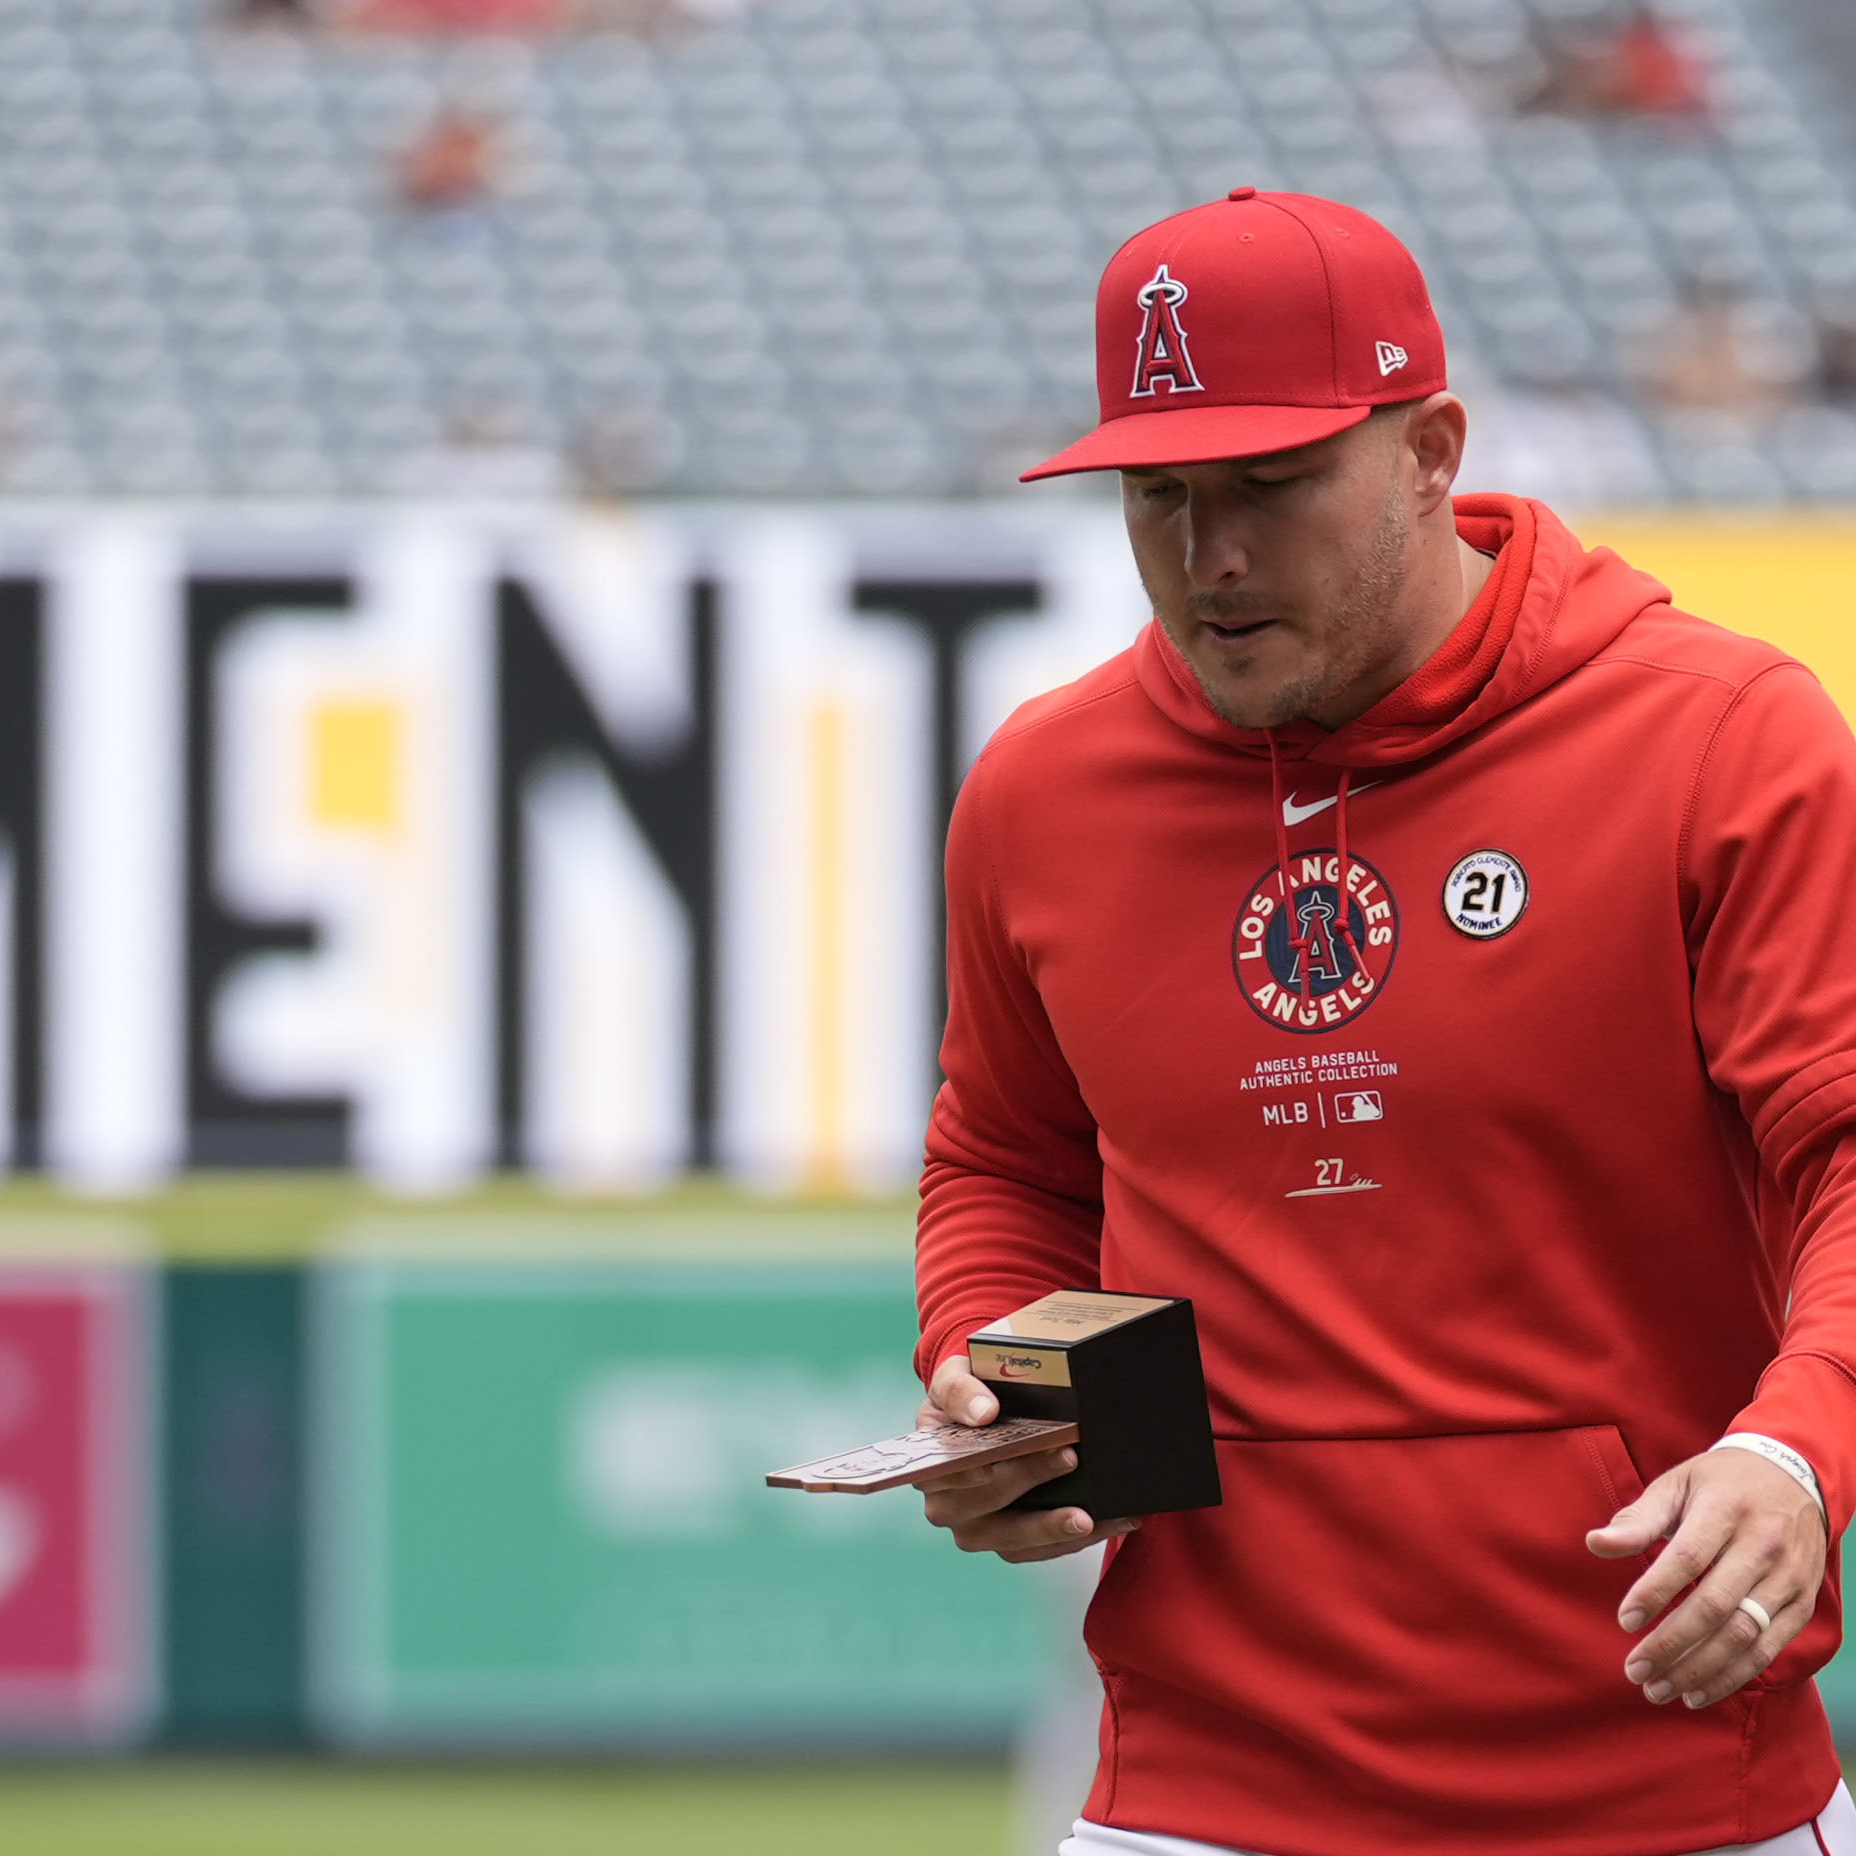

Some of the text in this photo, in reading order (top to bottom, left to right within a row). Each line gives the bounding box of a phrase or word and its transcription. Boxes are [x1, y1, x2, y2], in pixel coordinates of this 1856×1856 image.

[1462, 871, 1506, 914] 21
[1239, 894, 1274, 960] LOS
[1456, 912, 1503, 931] NOMINEE
[1253, 970, 1375, 1026] ANGELS
[1254, 1049, 1380, 1075] ANGELS BASEBALL
[1240, 1063, 1399, 1091] AUTHENTIC COLLECTION
[1262, 1102, 1309, 1126] MLB
[1314, 1158, 1344, 1186] 27
[1780, 1451, 1813, 1481] Joseph
